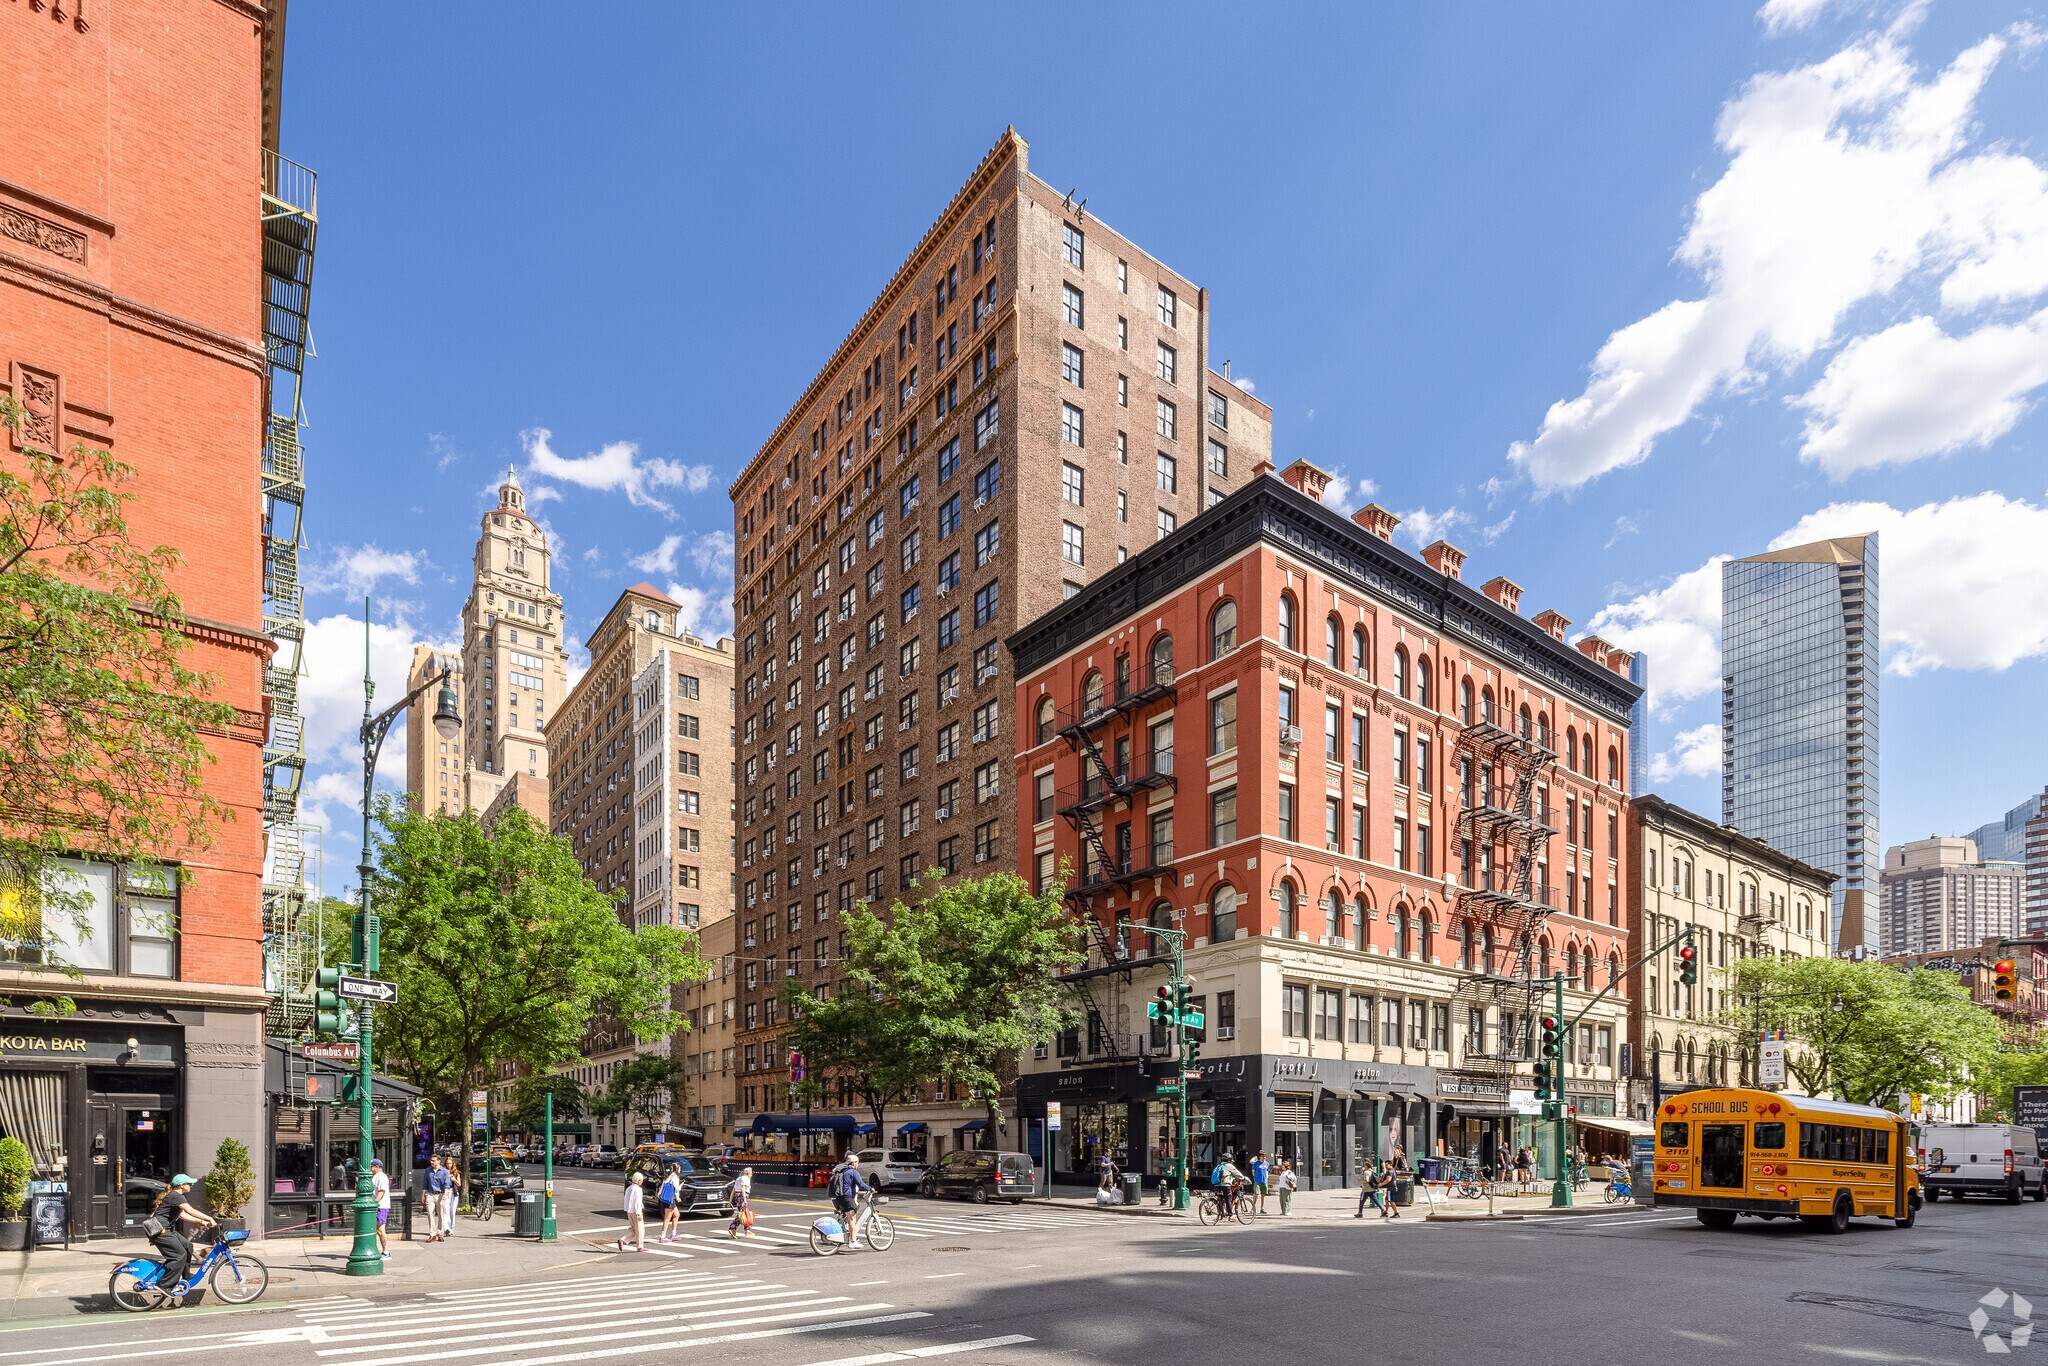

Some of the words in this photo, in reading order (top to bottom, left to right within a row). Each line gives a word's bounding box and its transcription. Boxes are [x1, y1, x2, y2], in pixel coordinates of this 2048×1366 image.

[348, 983, 365, 993] ONE
[372, 986, 389, 996] WAY
[51, 1038, 87, 1051] BAR
[304, 1045, 342, 1057] Columbus
[344, 1049, 355, 1057] Av
[1356, 1068, 1381, 1077] salon
[1058, 1076, 1083, 1086] salon
[1441, 1083, 1459, 1093] WEST
[1460, 1084, 1475, 1094] SIDE
[1691, 1102, 1726, 1114] SCHOOL
[1729, 1101, 1748, 1113] BUS
[1666, 1148, 1689, 1156] 2119
[55, 1183, 65, 1193] A
